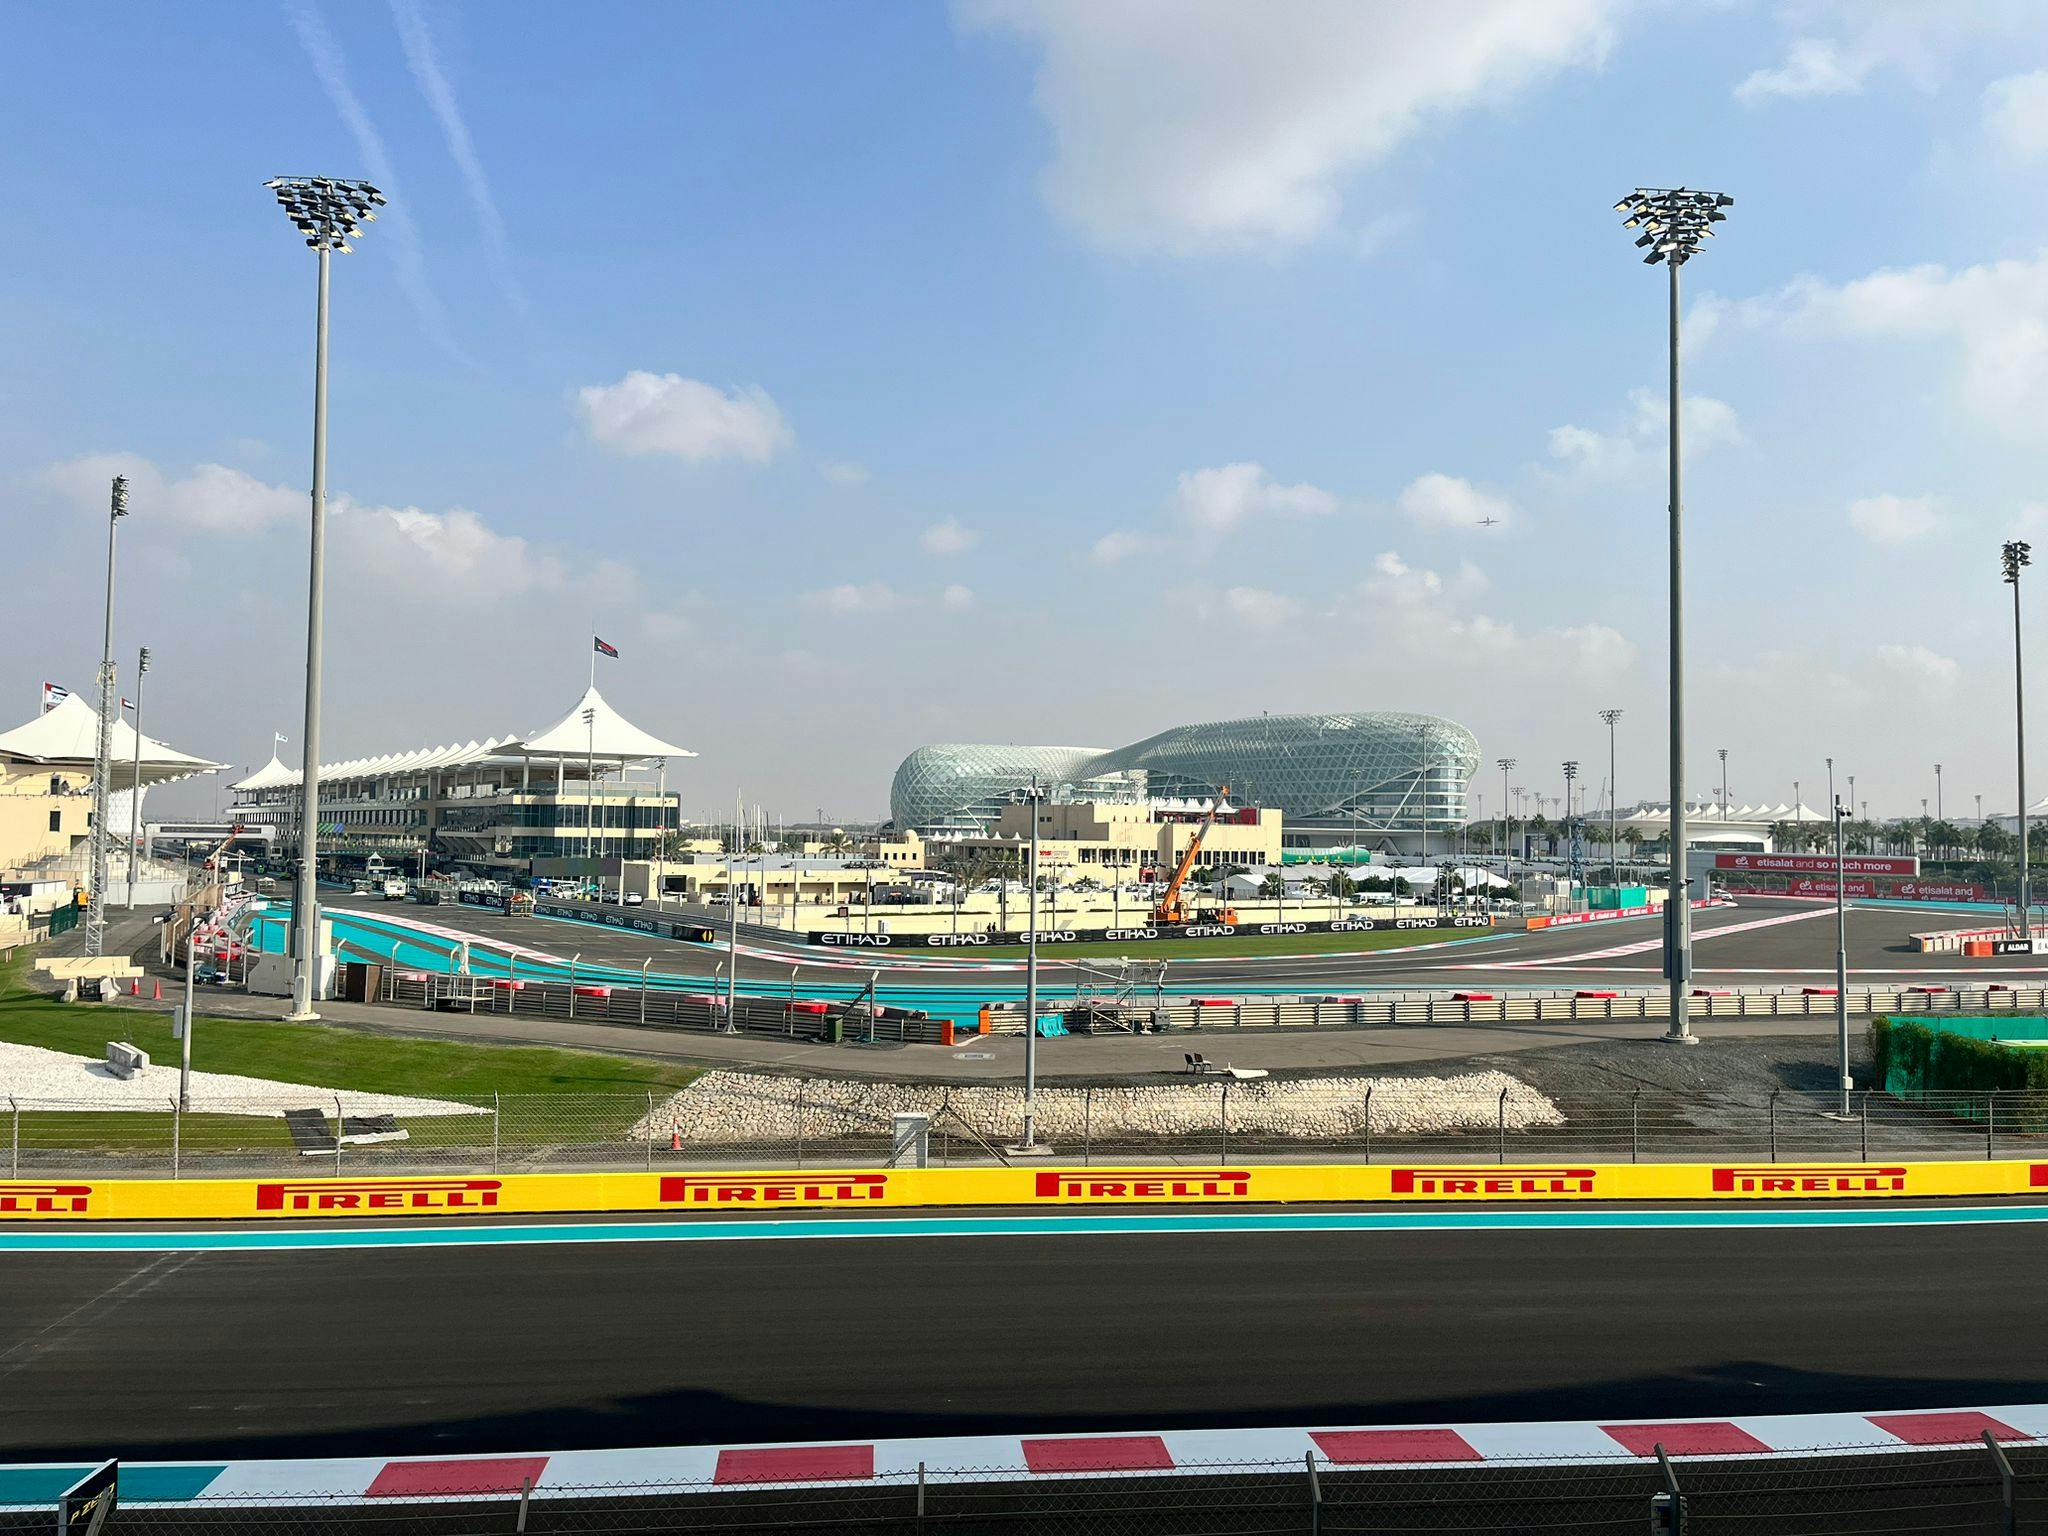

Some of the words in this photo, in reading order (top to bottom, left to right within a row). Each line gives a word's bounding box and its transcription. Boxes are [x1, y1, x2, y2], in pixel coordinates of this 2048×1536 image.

[1757, 859, 1794, 868] etisalat
[1796, 860, 1814, 869] and
[1863, 862, 1892, 871] more
[1815, 883, 1846, 892] etisalt
[1848, 884, 1865, 892] and
[1918, 885, 1953, 895] etisalat
[1954, 887, 1973, 896] and
[605, 915, 624, 926] ETIHAD
[633, 919, 653, 931] ETIHAD
[1330, 921, 1374, 931] ETIHAD
[1396, 918, 1438, 929] ETIHAD
[1454, 916, 1489, 927] ETIHAD
[1105, 929, 1158, 940] ETIHAD
[1185, 926, 1235, 937] ETIHAD
[1260, 924, 1306, 935] ETIHAD
[821, 933, 891, 946] ETIHAD
[928, 934, 988, 946] ETIHAD
[2007, 943, 2029, 951] ALDAR
[1035, 1171, 1251, 1197] PIRELLI
[1391, 1169, 1596, 1193] PIRELLI
[1712, 1167, 1907, 1191] PIRELLI
[659, 1174, 887, 1202] PIRELLI
[257, 1180, 502, 1210] PIRELLI
[69, 1510, 80, 1525] P
